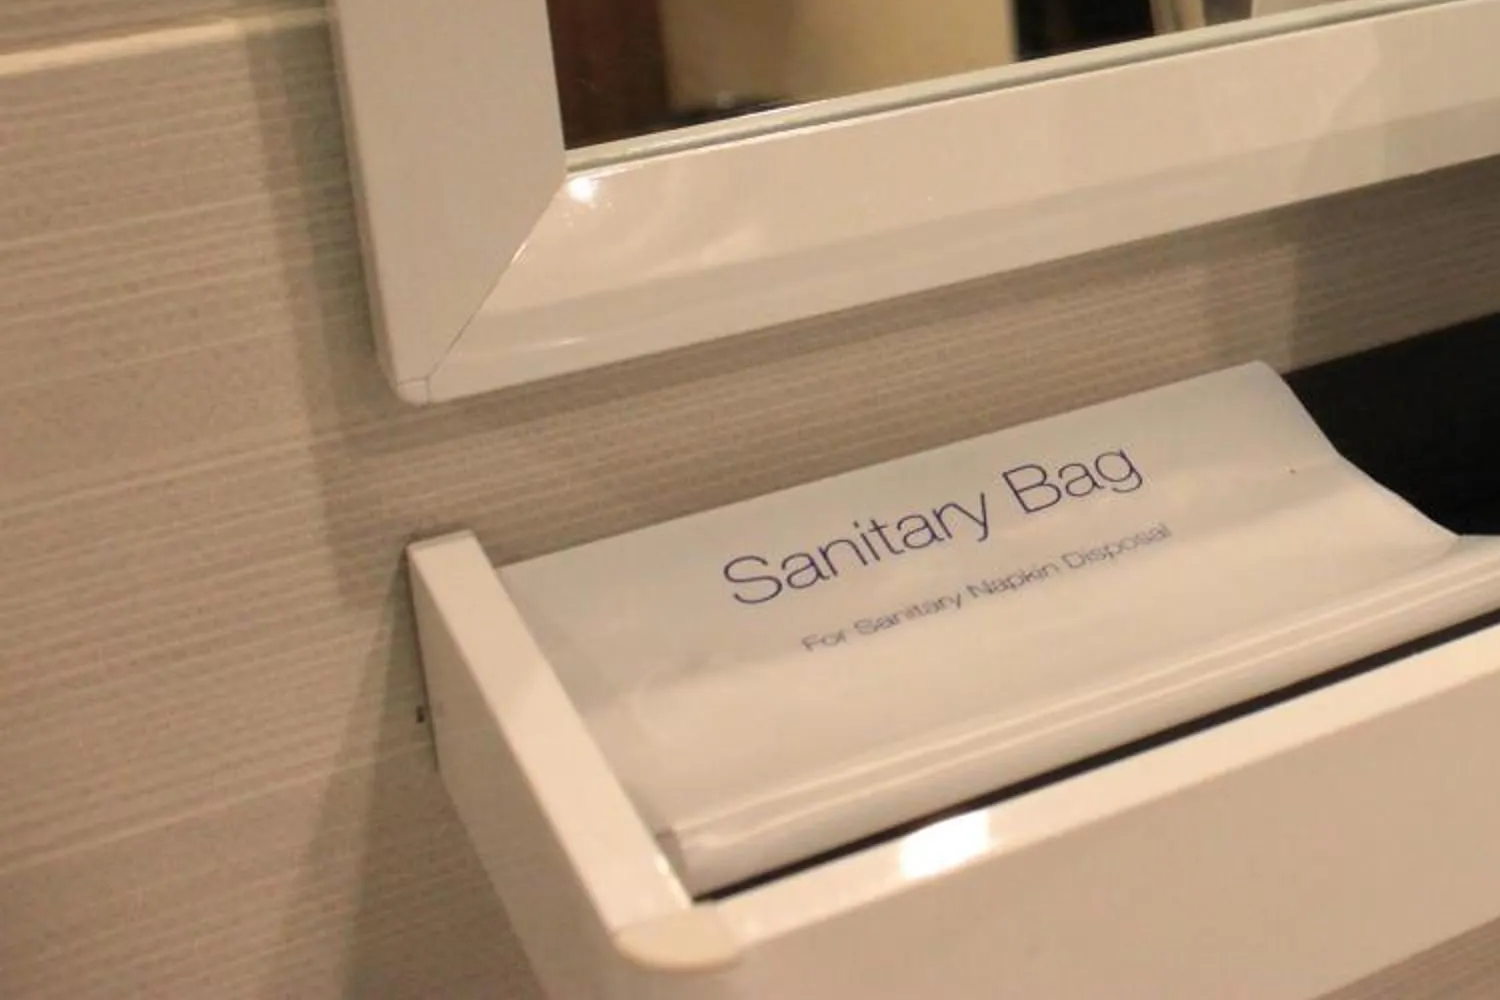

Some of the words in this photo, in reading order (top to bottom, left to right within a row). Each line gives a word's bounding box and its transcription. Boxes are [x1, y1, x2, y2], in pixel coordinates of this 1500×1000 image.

[722, 491, 990, 605] Sanitary
[1001, 447, 1144, 515] Bag
[801, 630, 847, 652] For
[853, 590, 963, 635] Sanitary
[965, 561, 1060, 601] Napkin
[1060, 522, 1172, 571] Disposal
